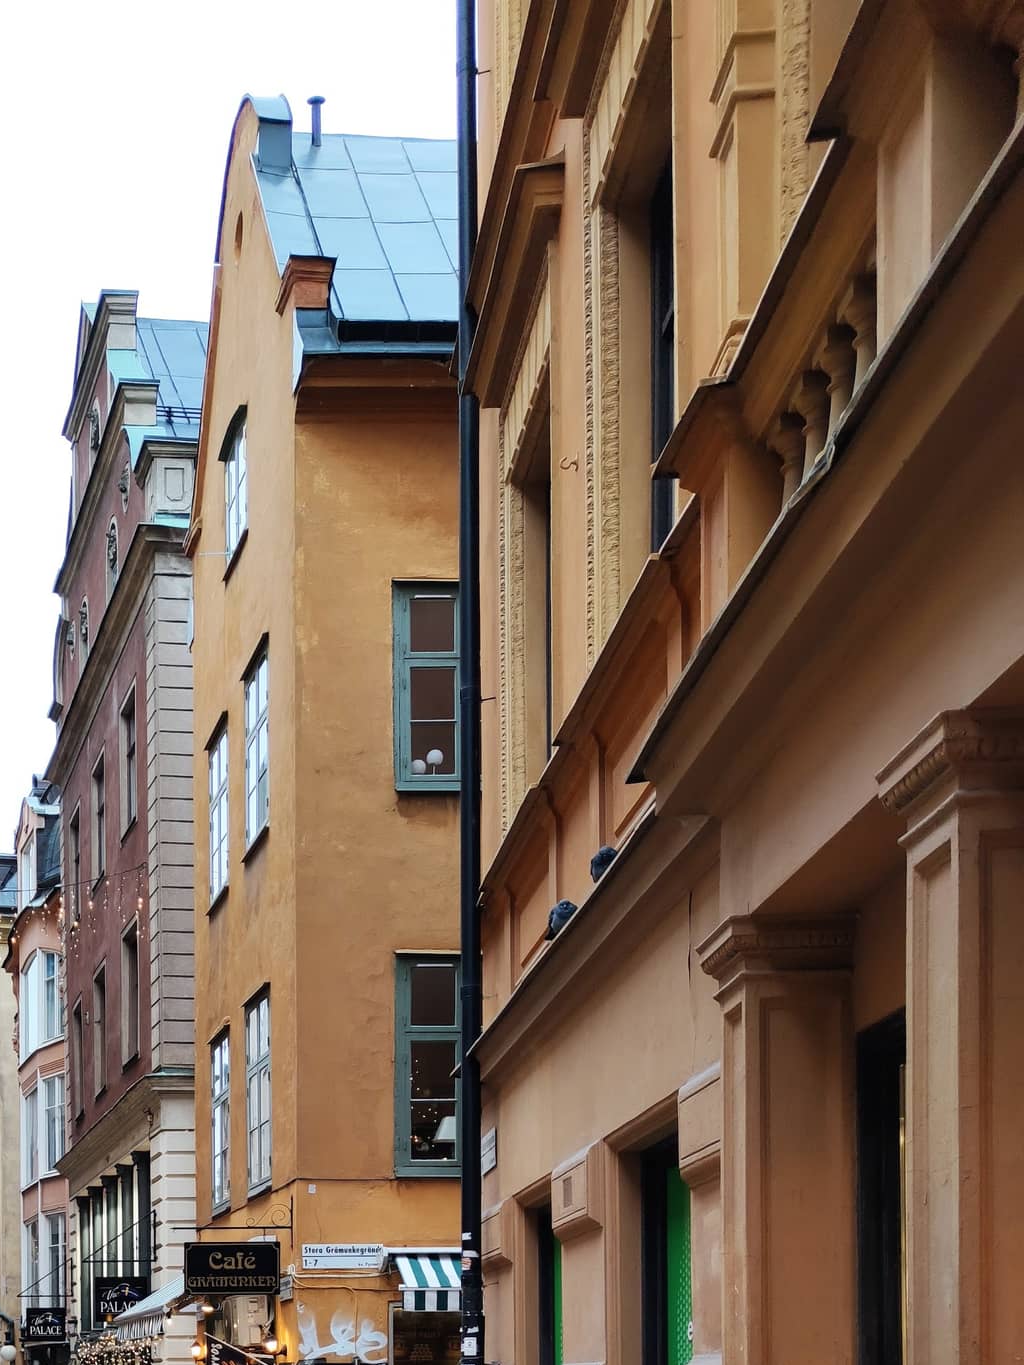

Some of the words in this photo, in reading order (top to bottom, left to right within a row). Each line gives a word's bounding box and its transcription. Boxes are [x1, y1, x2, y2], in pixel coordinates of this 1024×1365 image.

[304, 1246, 323, 1254] Stora
[209, 1251, 256, 1270] Café
[187, 1274, 276, 1287] GRÅMUNKEN
[100, 1301, 140, 1313] PALAC
[29, 1326, 63, 1335] PALACE
